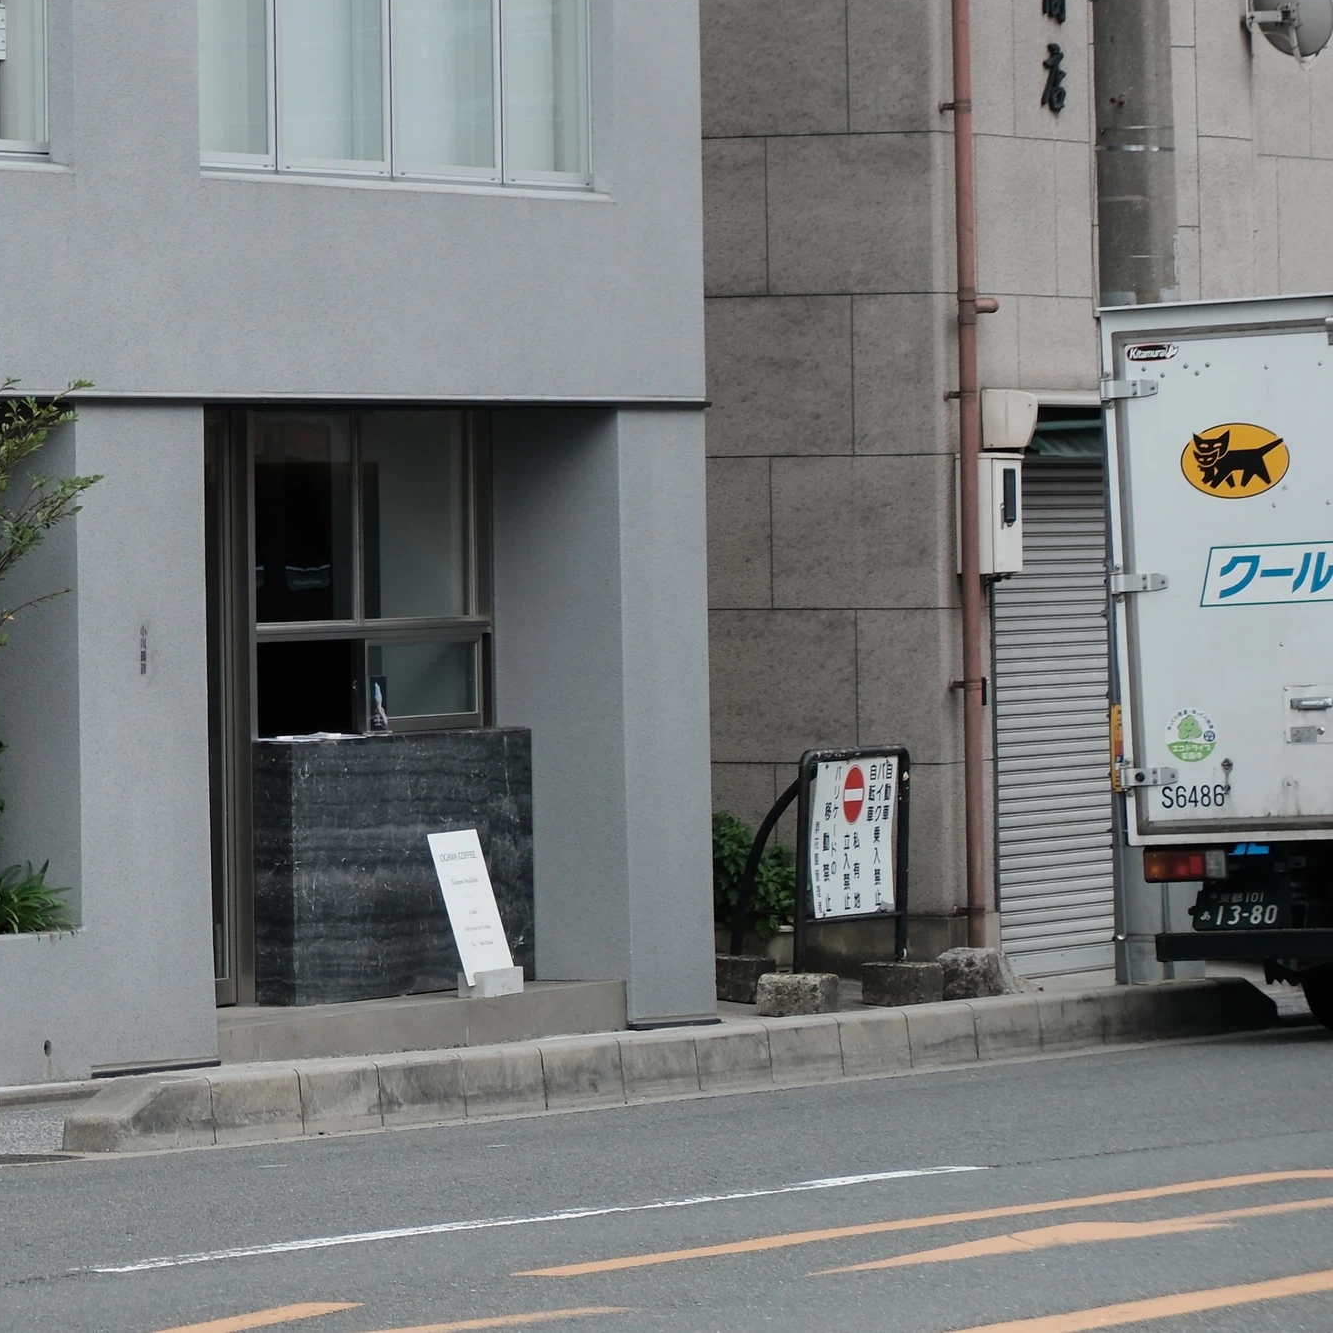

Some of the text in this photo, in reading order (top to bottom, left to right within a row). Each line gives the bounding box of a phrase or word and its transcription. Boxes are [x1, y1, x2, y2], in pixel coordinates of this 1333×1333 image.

[1129, 347, 1165, 360] Kitamura
[1218, 551, 1333, 599] クール
[1161, 784, 1225, 809] S6486
[843, 832, 851, 911] 立入禁止
[1216, 904, 1279, 926] 13-80
